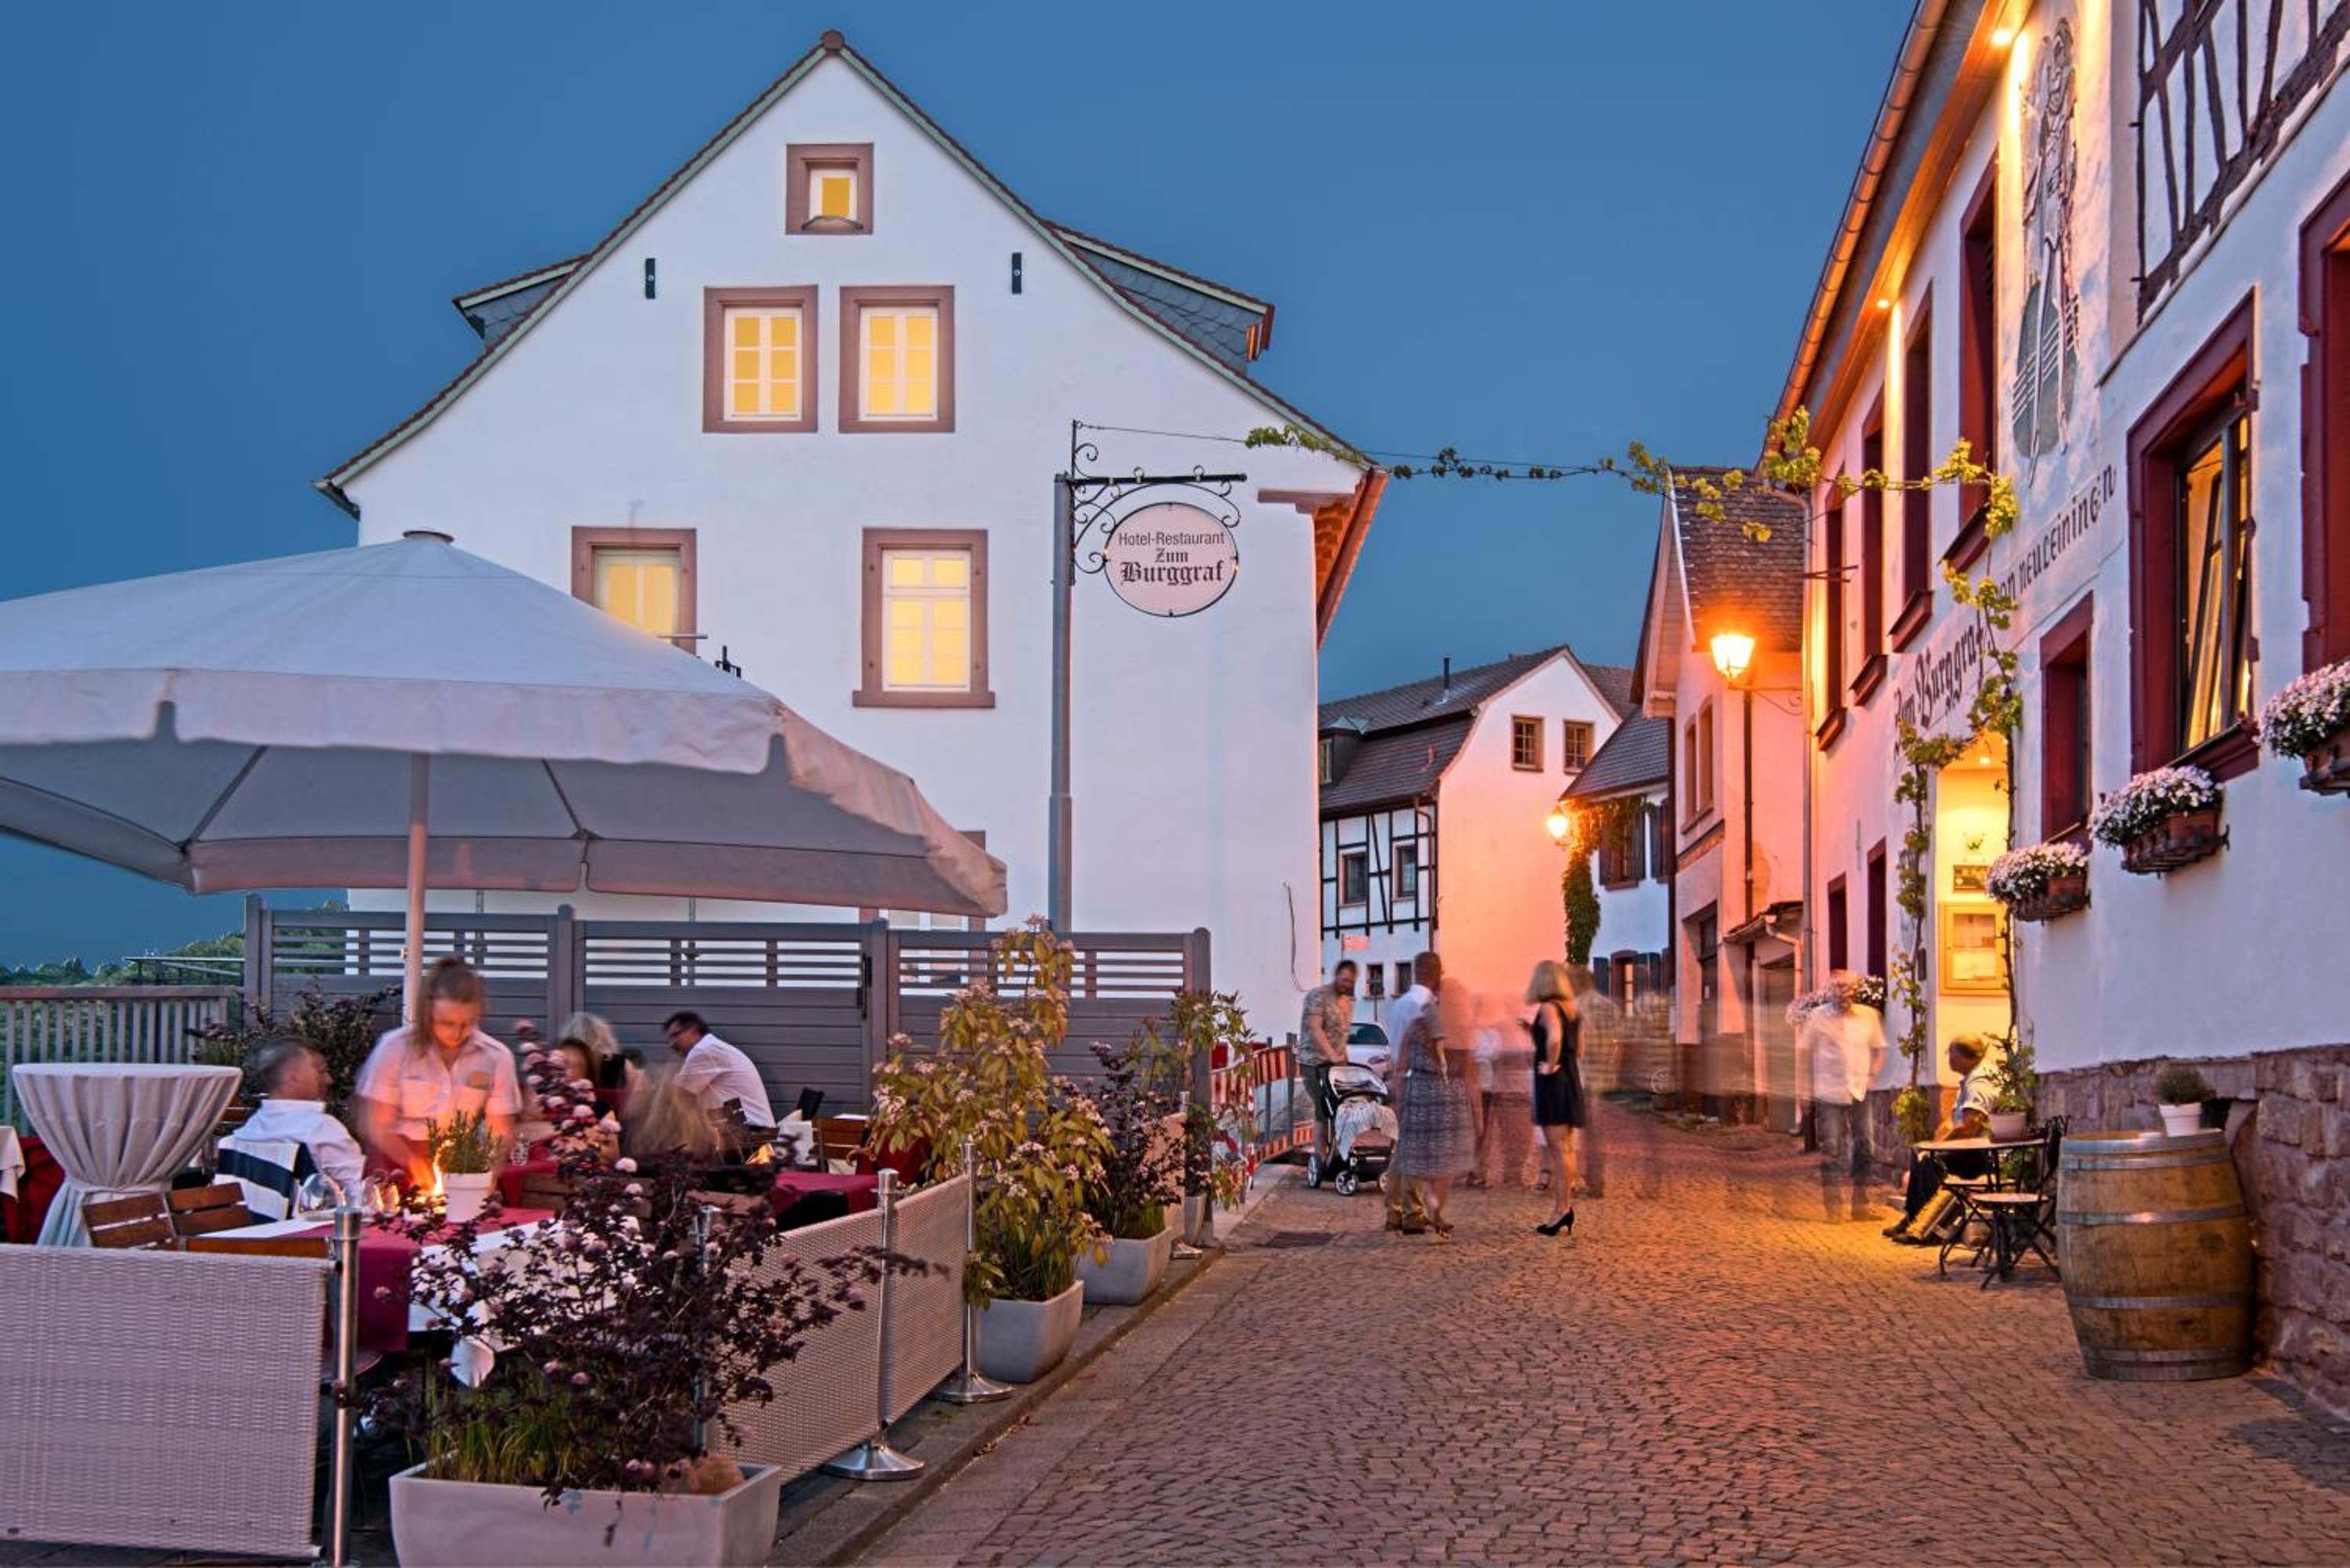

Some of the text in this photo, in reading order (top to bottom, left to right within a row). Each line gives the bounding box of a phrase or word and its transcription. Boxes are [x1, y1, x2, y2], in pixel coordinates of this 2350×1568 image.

[1119, 531, 1225, 546] Hotel-Restaurant
[1155, 548, 1188, 563] Zum
[1120, 560, 1224, 586] Burggraf
